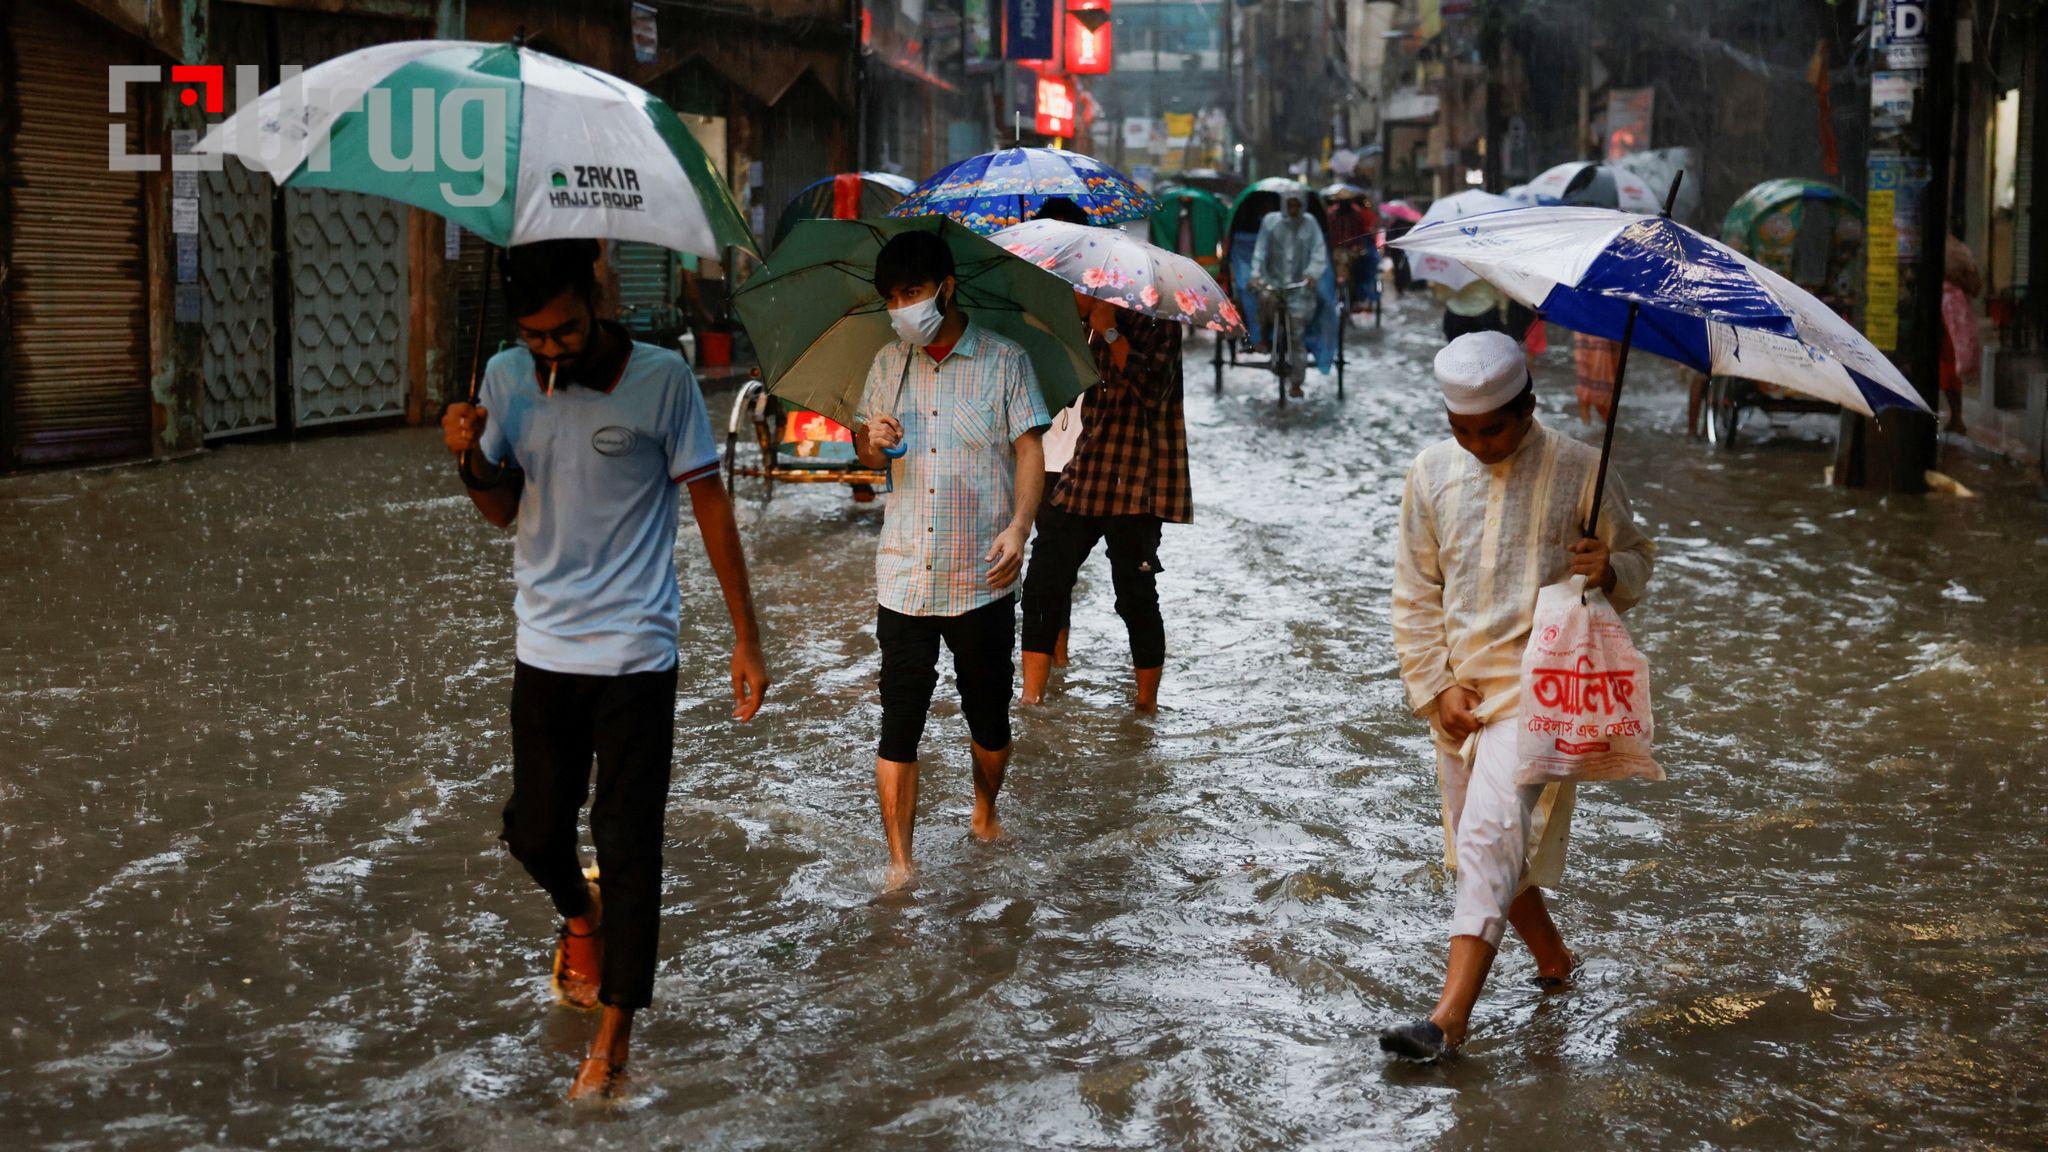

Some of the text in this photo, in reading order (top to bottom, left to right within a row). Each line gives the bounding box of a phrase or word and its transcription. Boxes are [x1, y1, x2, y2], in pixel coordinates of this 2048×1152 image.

[574, 165, 640, 191] ZAKIR
[549, 191, 643, 208] HAJJ GROUP
[1532, 655, 1634, 715] আলিফ
